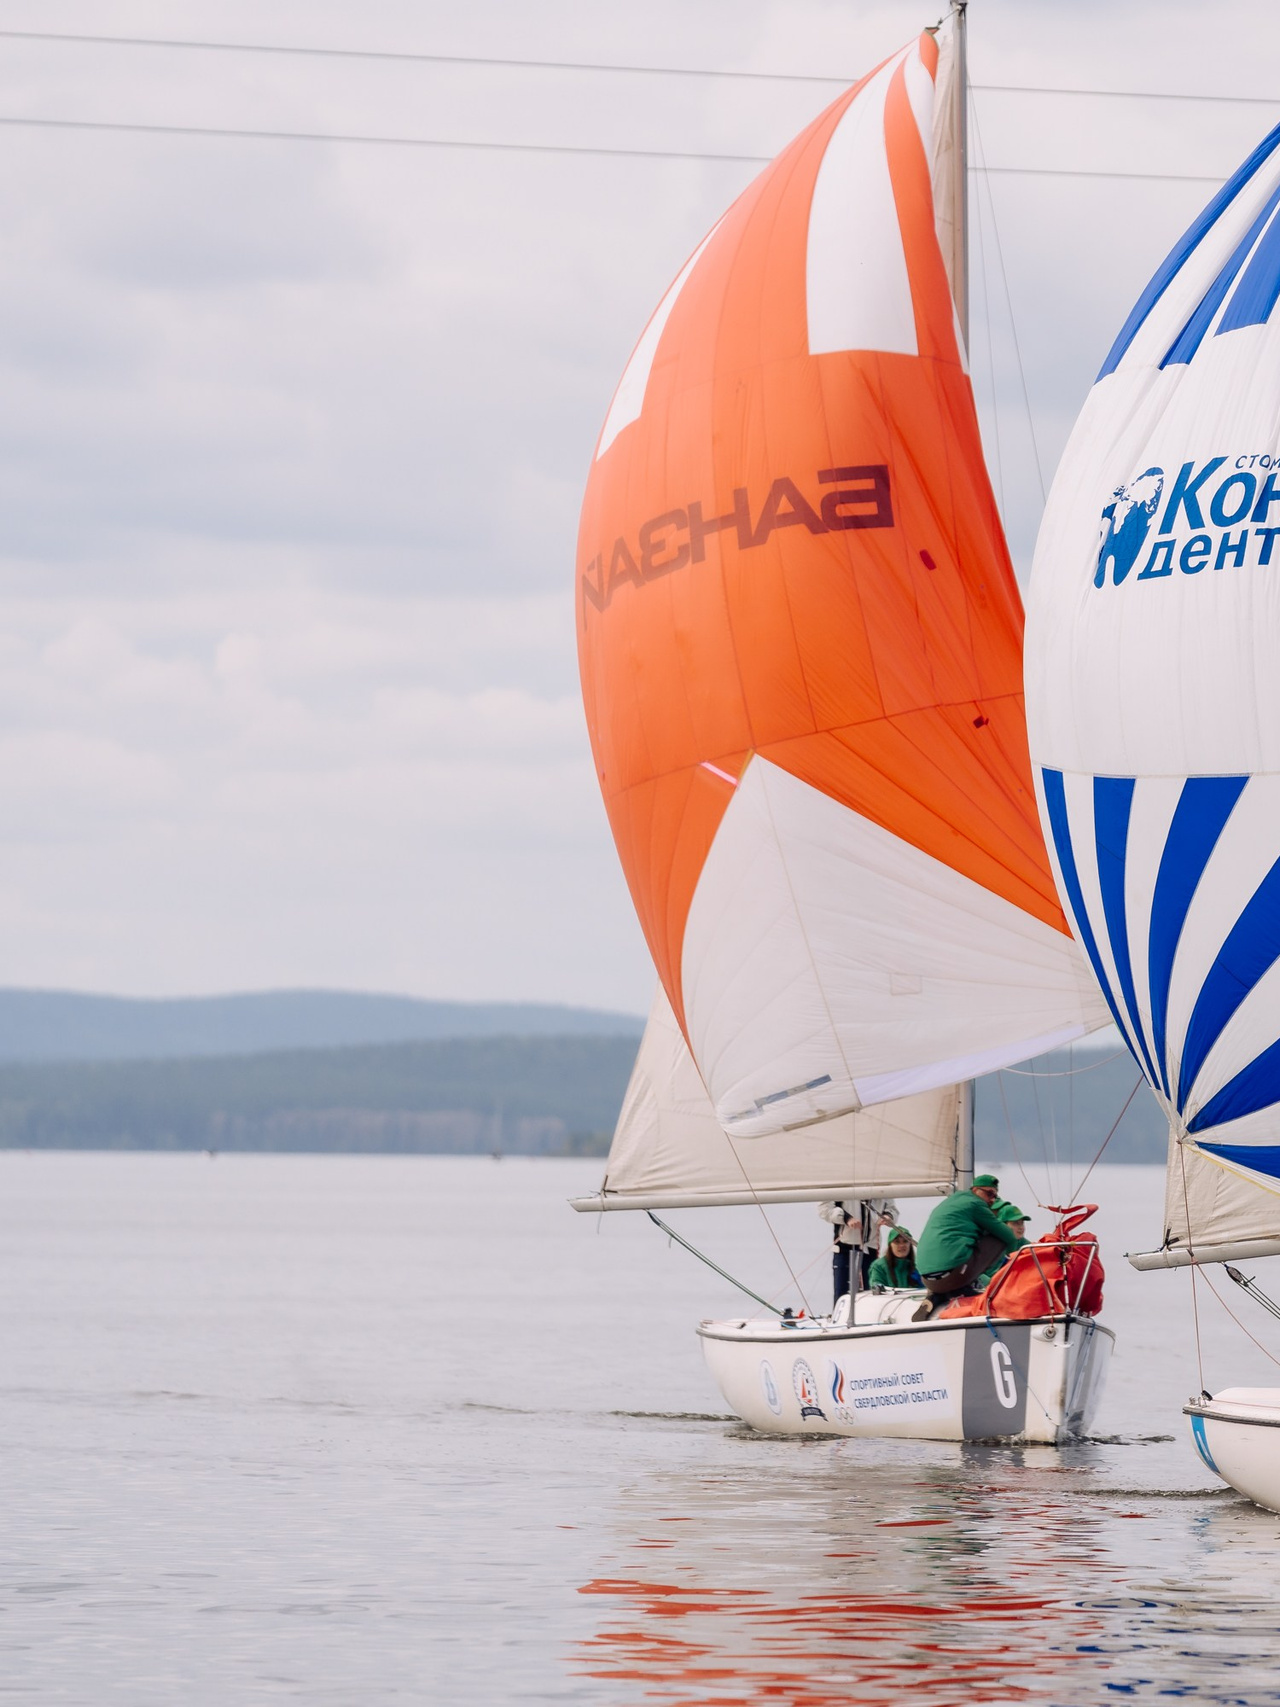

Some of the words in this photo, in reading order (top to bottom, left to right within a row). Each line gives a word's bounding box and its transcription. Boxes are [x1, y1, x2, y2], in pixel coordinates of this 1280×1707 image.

[850, 1373, 900, 1391] СПОРТИВНЫЙ
[901, 1372, 924, 1386] СОВЕТ
[990, 1341, 1018, 1409] G
[854, 1390, 910, 1410] СВЕРДЛОВСКОЙ
[911, 1389, 949, 1403] ОБЛАСТИ
